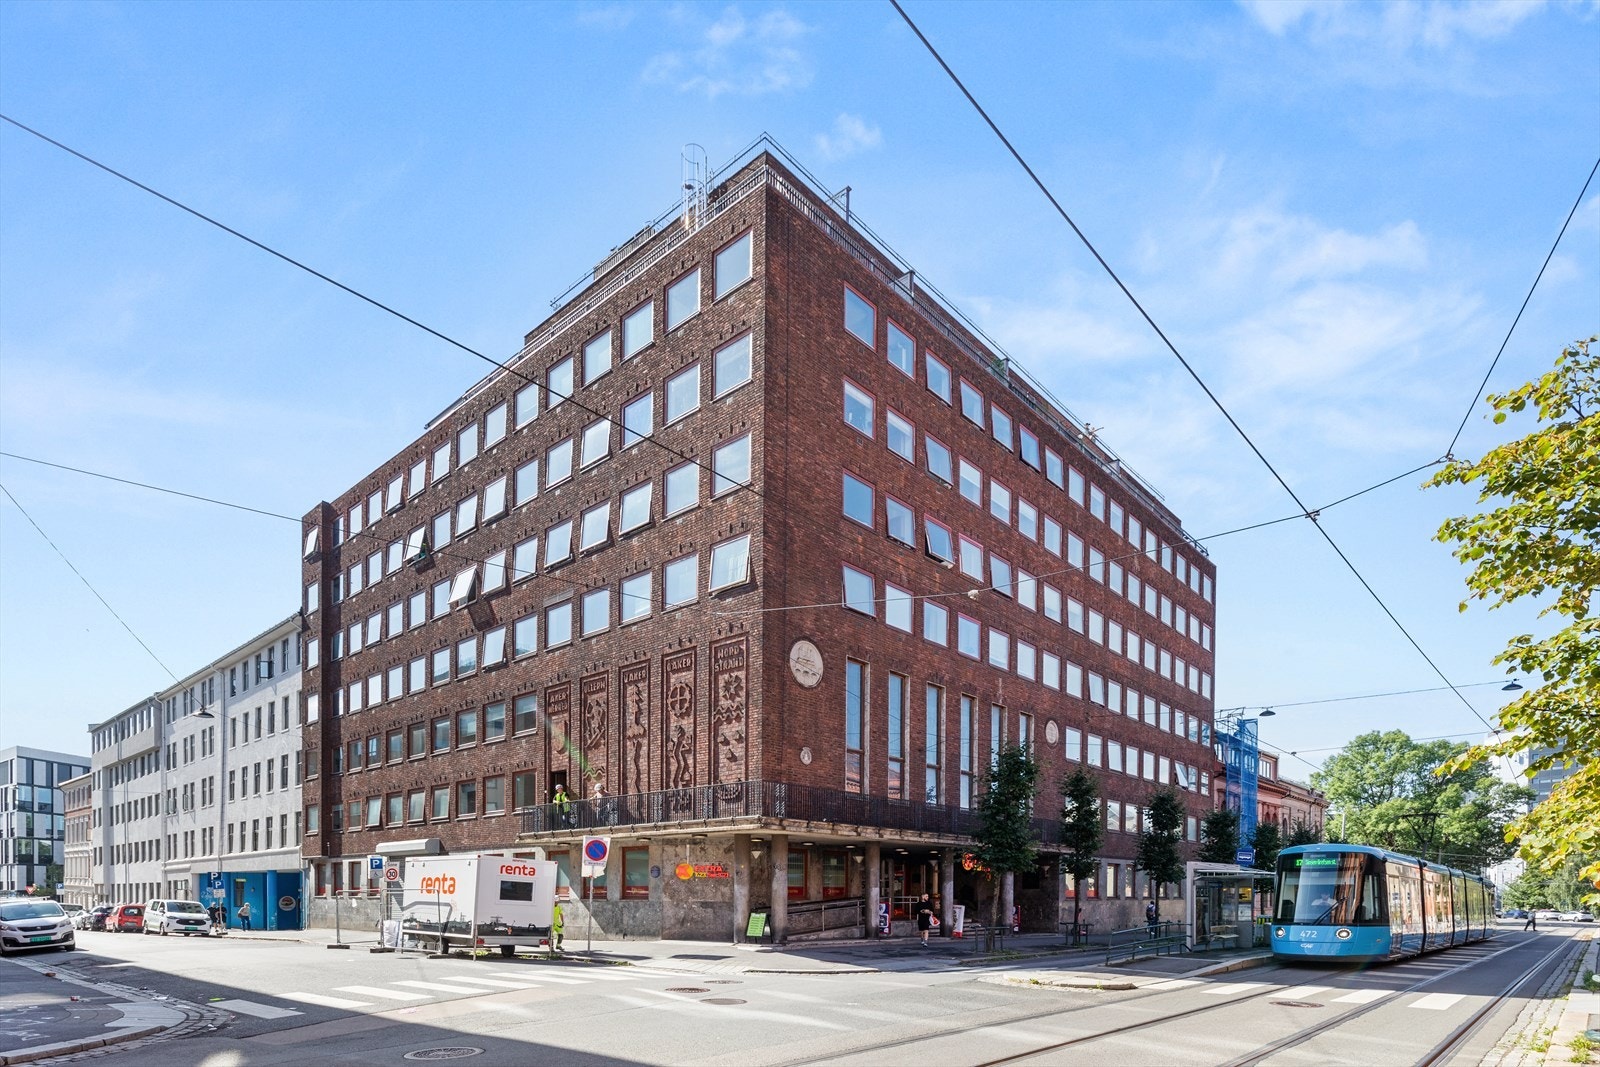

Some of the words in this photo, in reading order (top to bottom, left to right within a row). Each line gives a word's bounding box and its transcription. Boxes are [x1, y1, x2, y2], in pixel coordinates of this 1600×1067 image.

[714, 656, 744, 672] STRAND
[372, 860, 380, 868] P
[500, 864, 536, 876] renta
[420, 873, 456, 894] renta
[1300, 930, 1317, 938] 472
